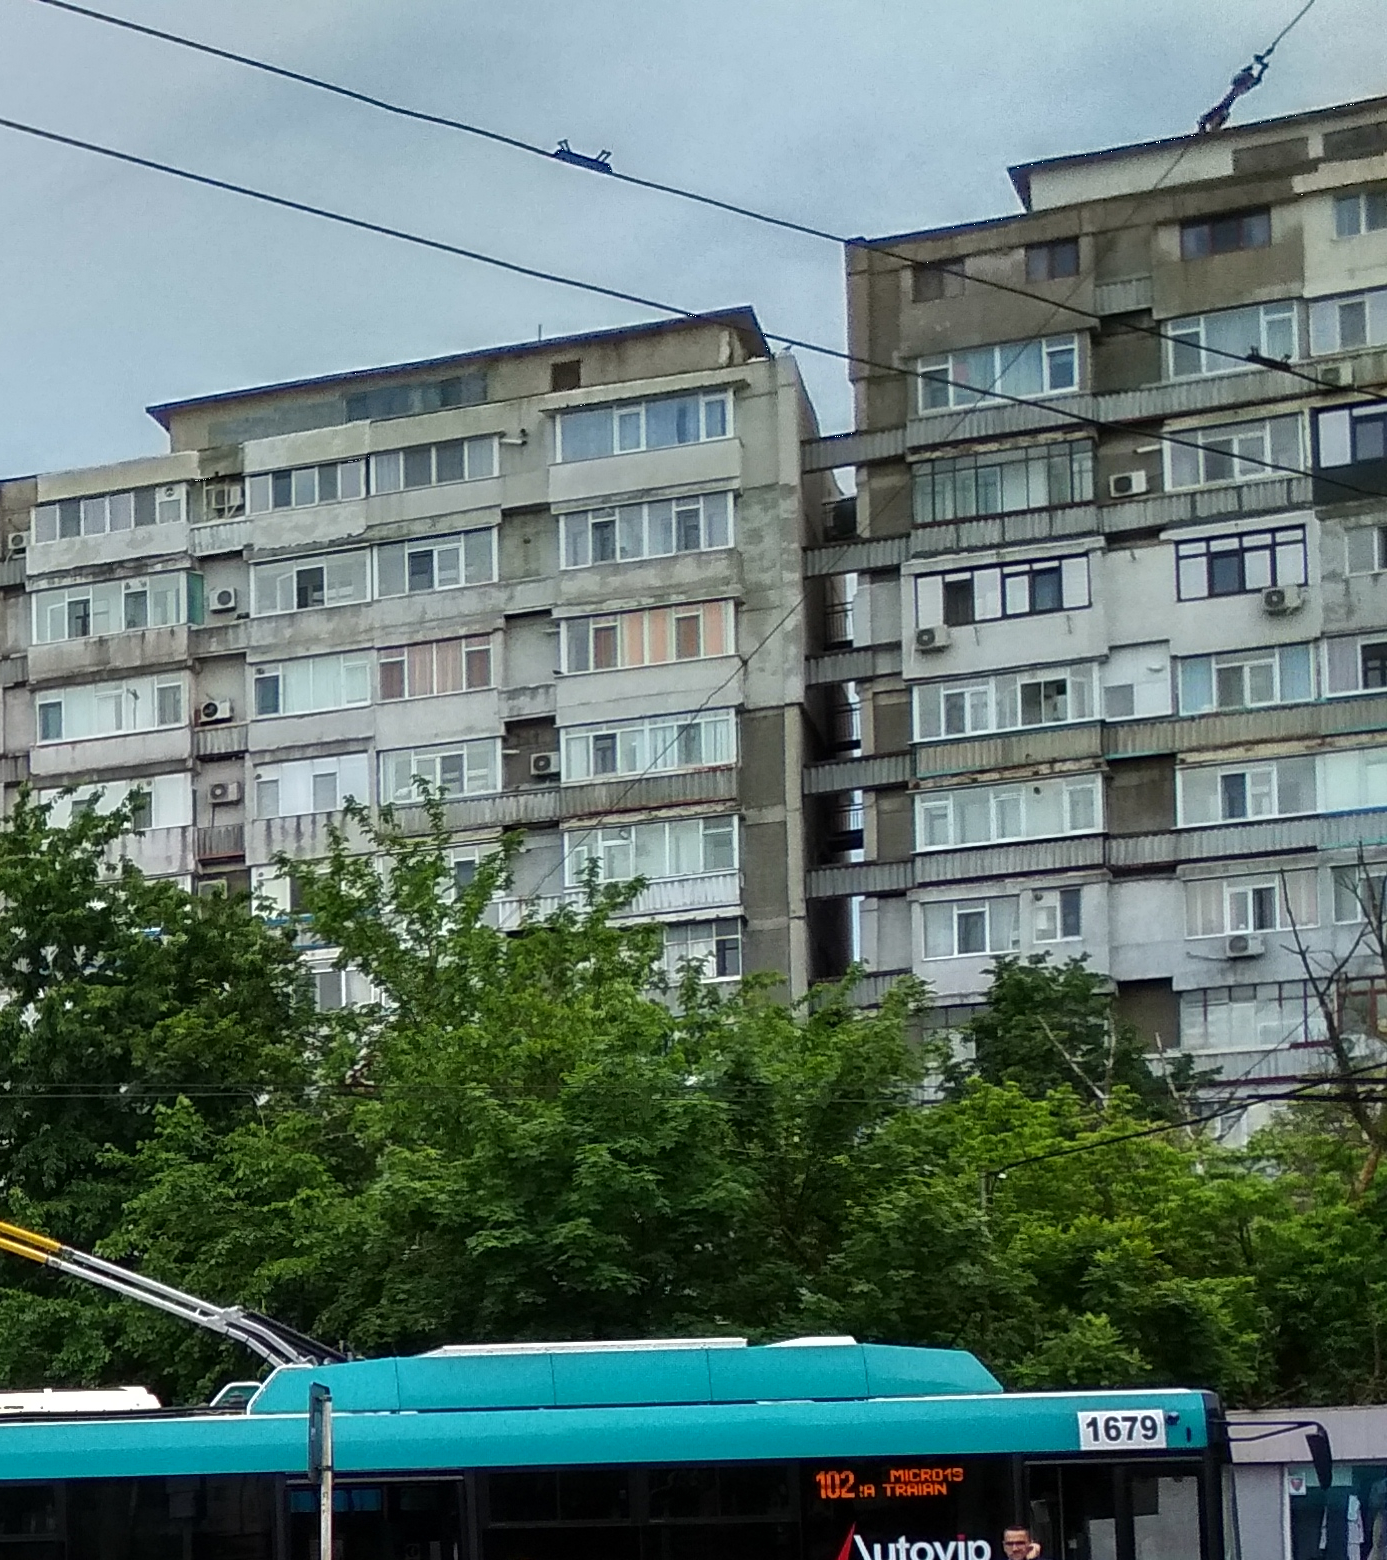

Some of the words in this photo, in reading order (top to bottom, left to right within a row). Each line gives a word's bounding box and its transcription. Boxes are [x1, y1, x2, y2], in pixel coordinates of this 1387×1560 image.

[1085, 1414, 1159, 1442] 1679
[815, 1470, 856, 1499] 102
[881, 1482, 948, 1498] TRAIAN
